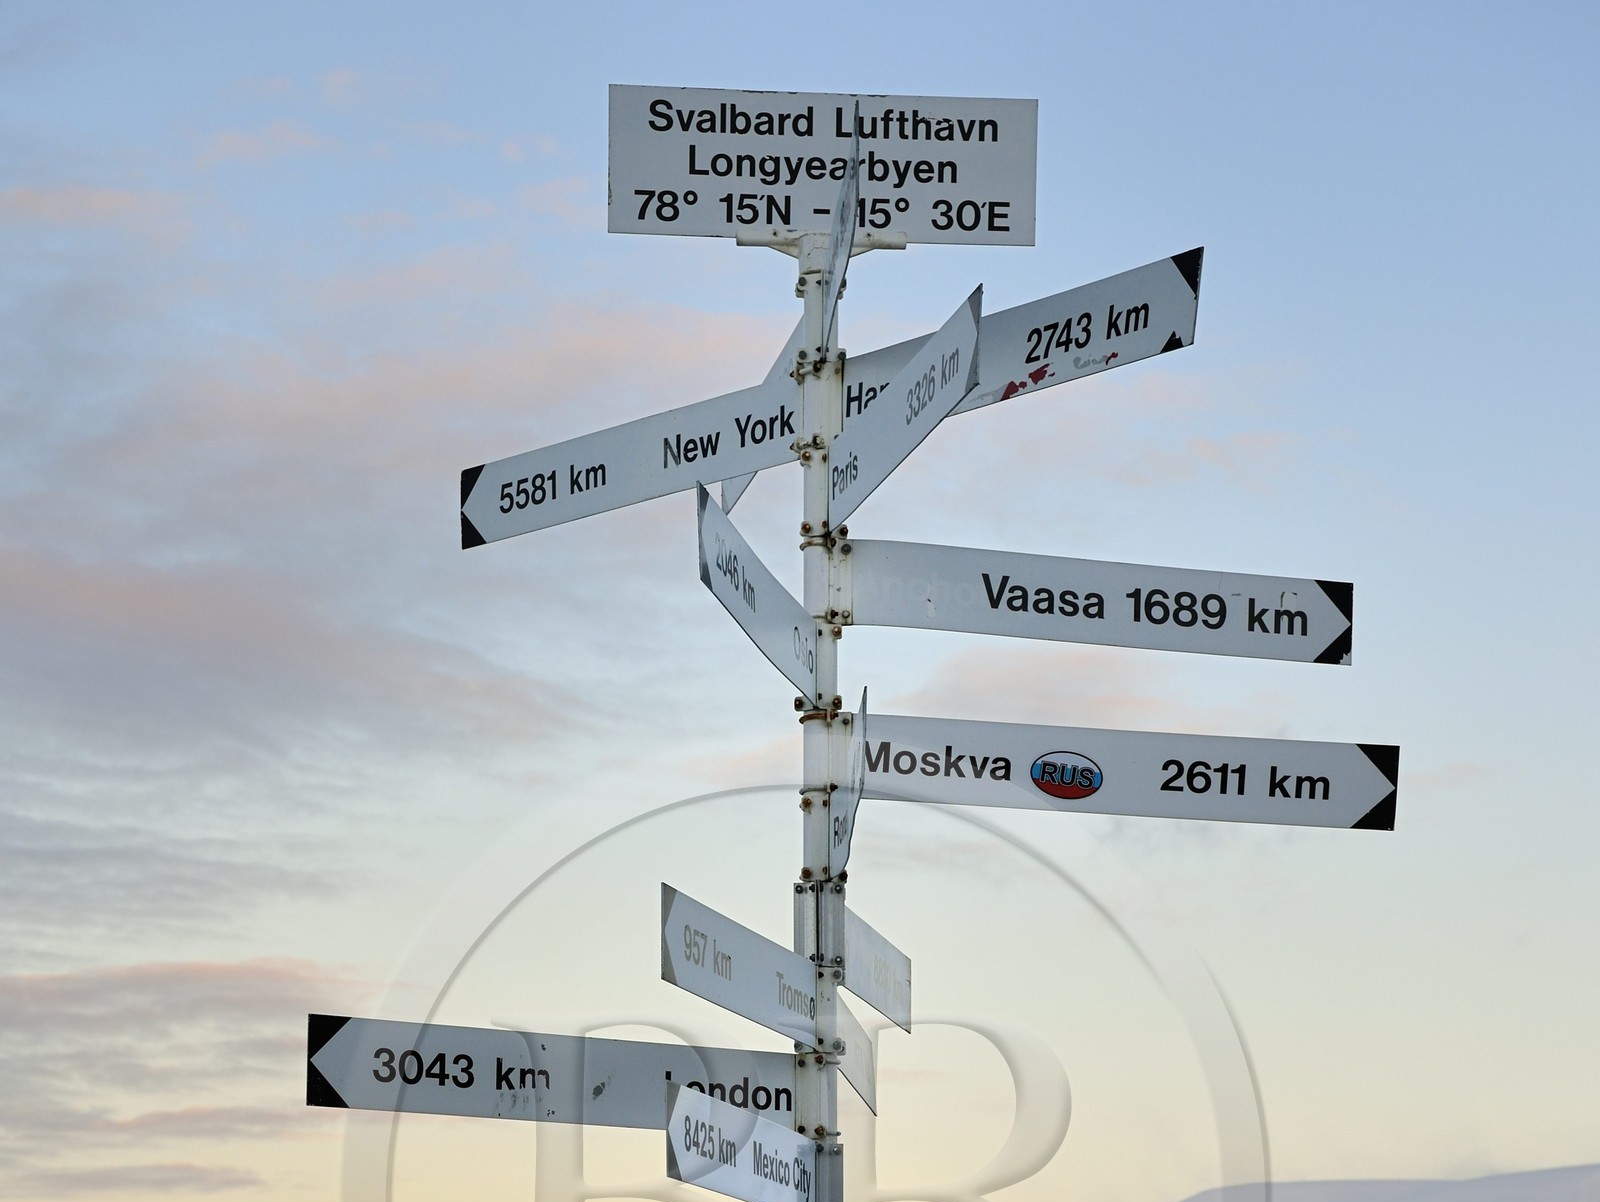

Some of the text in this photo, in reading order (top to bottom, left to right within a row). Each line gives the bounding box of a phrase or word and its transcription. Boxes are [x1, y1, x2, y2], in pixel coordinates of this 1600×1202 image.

[648, 99, 998, 142] Svalbard Lufthavn
[688, 144, 958, 188] Longyearbyen
[634, 189, 698, 222] 78°
[857, 197, 911, 229] 15°
[1024, 312, 1092, 364] 2743
[1106, 302, 1149, 340] km
[832, 347, 960, 501] Paris 3326 km
[499, 405, 796, 514] 5581 km New York
[715, 532, 814, 674] 2046 km Oslo
[981, 573, 1105, 620] Vaasa
[1125, 587, 1228, 630] 1689
[1247, 598, 1309, 637] km
[865, 740, 1331, 801] Moskva RUS 2611 km
[683, 924, 816, 1021] 957 km Tromsø
[372, 1047, 475, 1089] 3043
[496, 1057, 551, 1091] km
[684, 1115, 715, 1161] 8425
[718, 1127, 737, 1168] km
[753, 1140, 790, 1187] Mexico
